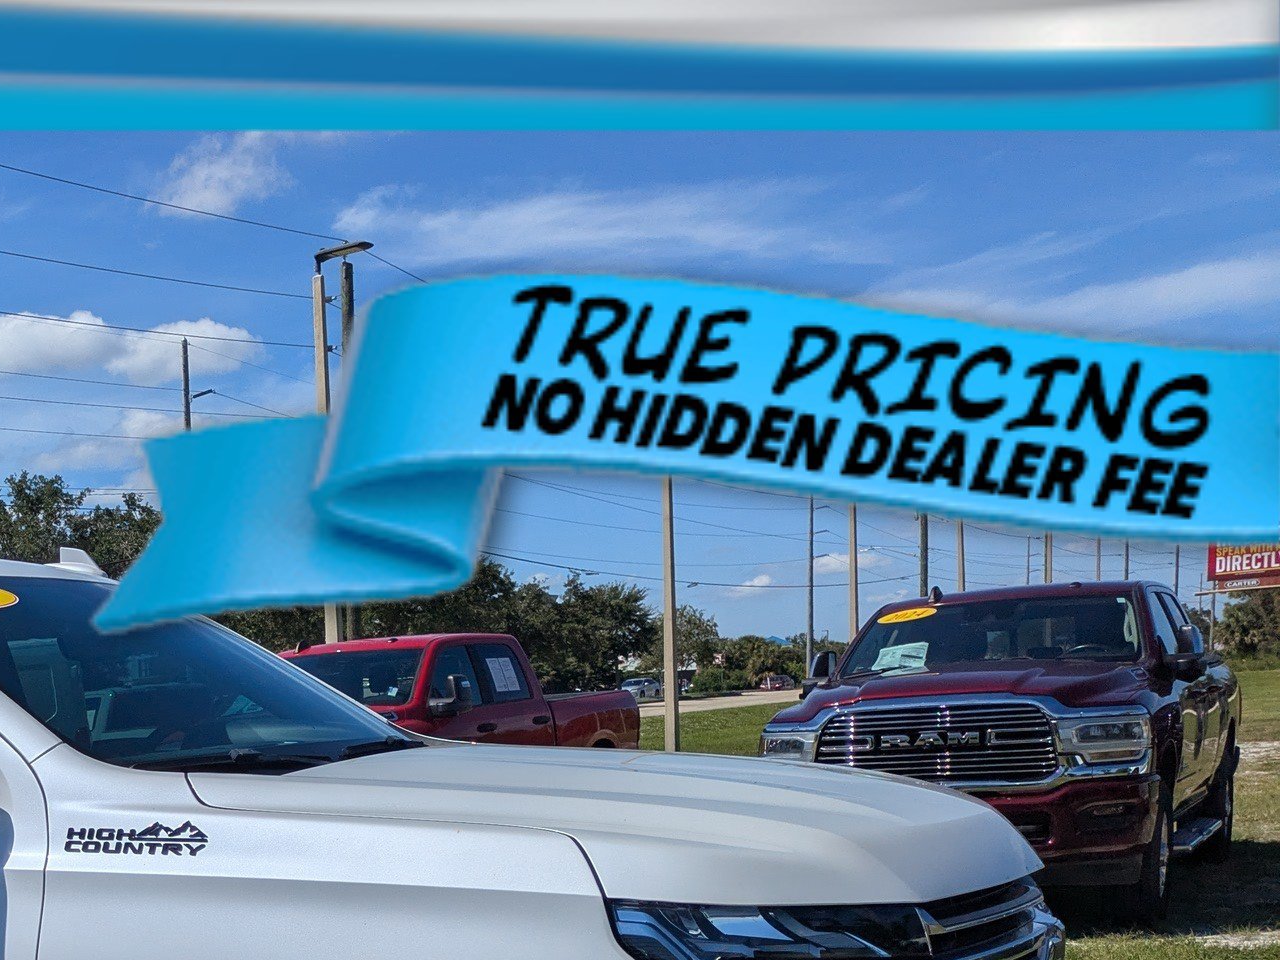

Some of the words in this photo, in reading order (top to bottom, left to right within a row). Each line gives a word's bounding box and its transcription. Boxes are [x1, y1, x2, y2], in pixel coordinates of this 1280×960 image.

[1216, 545, 1247, 557] SPEAK
[1249, 543, 1273, 554] WITH
[1215, 551, 1280, 573] DIRECTL
[1226, 580, 1257, 588] CARTER
[880, 731, 980, 749] RAM
[66, 827, 137, 841] HIGH
[64, 840, 207, 857] COUNTRY
